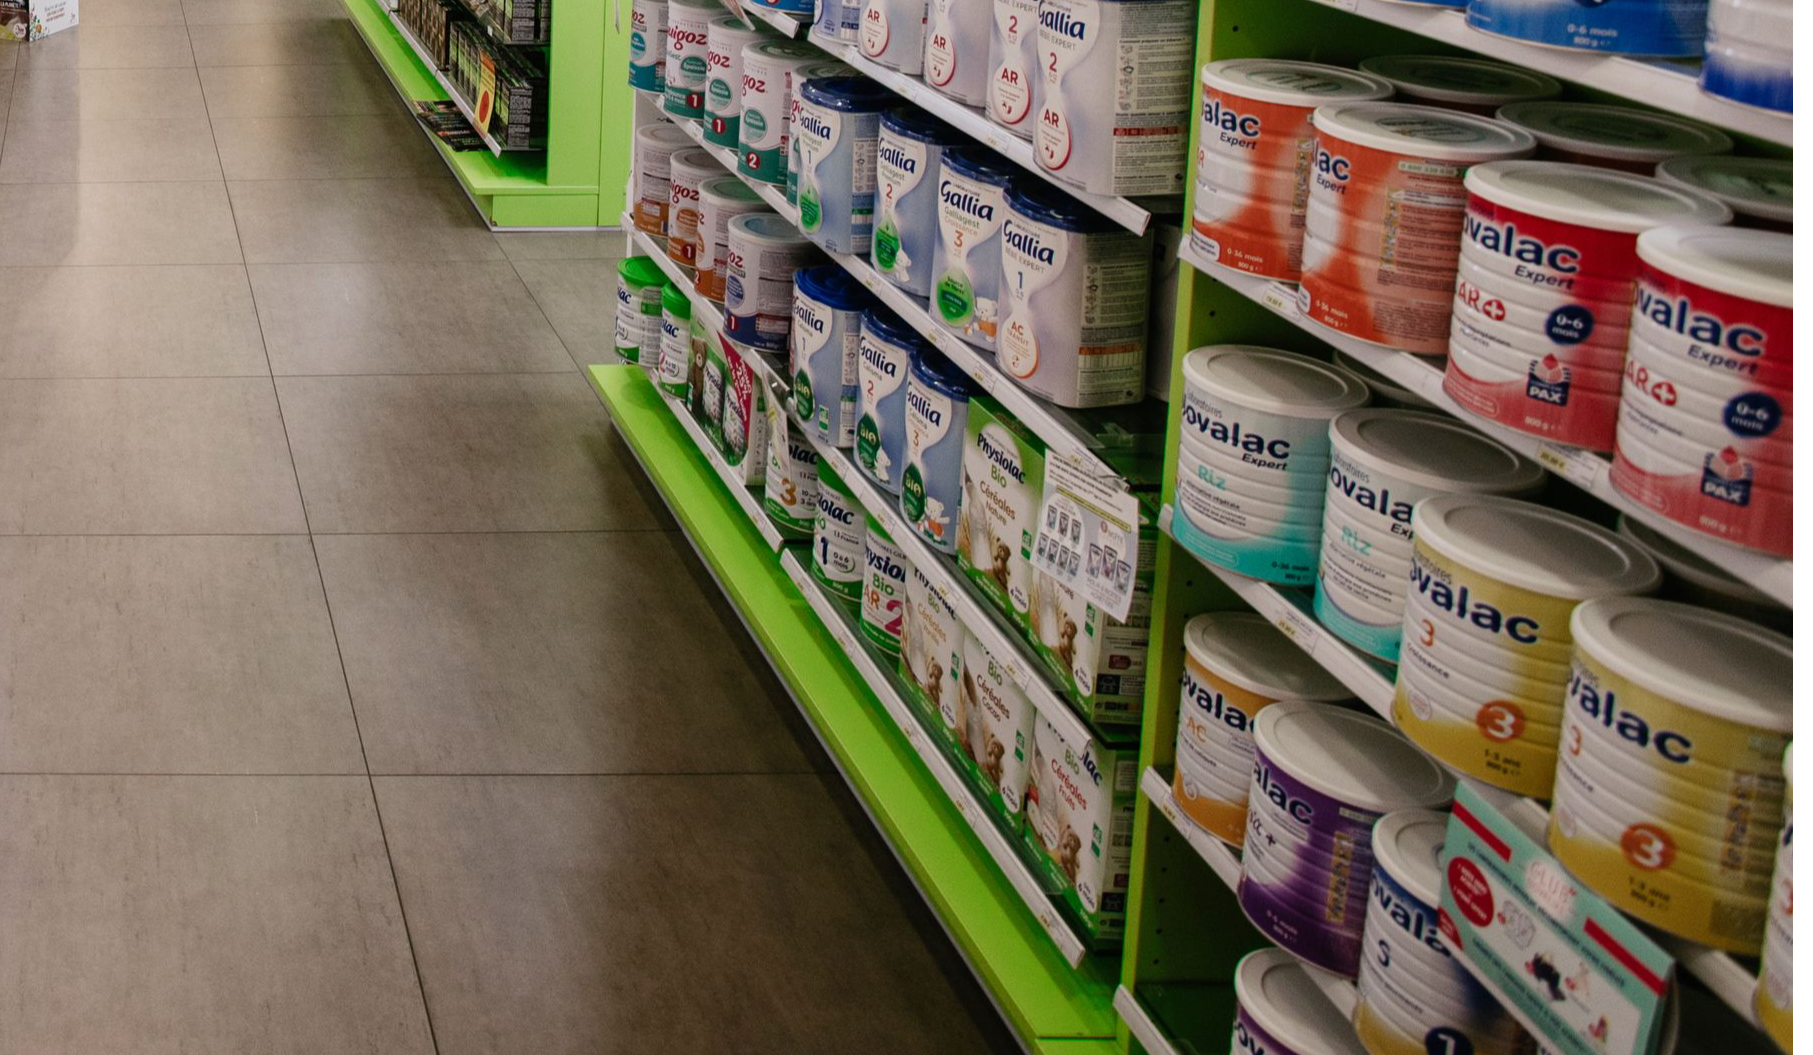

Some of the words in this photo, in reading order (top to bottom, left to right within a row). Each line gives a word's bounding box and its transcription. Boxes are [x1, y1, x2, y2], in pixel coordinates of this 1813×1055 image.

[867, 8, 880, 23] AR
[1038, 0, 1085, 40] Gallia
[934, 35, 945, 49] AR
[1591, 26, 1618, 38] mois
[1002, 68, 1018, 85] AR
[1044, 109, 1060, 128] AR
[1219, 131, 1257, 151] Expert
[941, 181, 994, 221] Gallia
[1004, 220, 1054, 265] Gallia
[1514, 264, 1575, 291] Expert
[1556, 310, 1585, 329] 0-6
[1552, 324, 1579, 341] mois
[1688, 344, 1758, 376] Expert
[1529, 383, 1564, 405] PAX
[1735, 397, 1769, 420] 0-6
[1731, 412, 1763, 431] mois
[977, 433, 1026, 486] Physiolac
[1241, 452, 1288, 472] Expert
[1198, 464, 1226, 492] Riz
[1703, 480, 1743, 504] PAX
[1341, 525, 1372, 556] Riz
[1485, 705, 1519, 738] 3
[1629, 831, 1664, 868] 3
